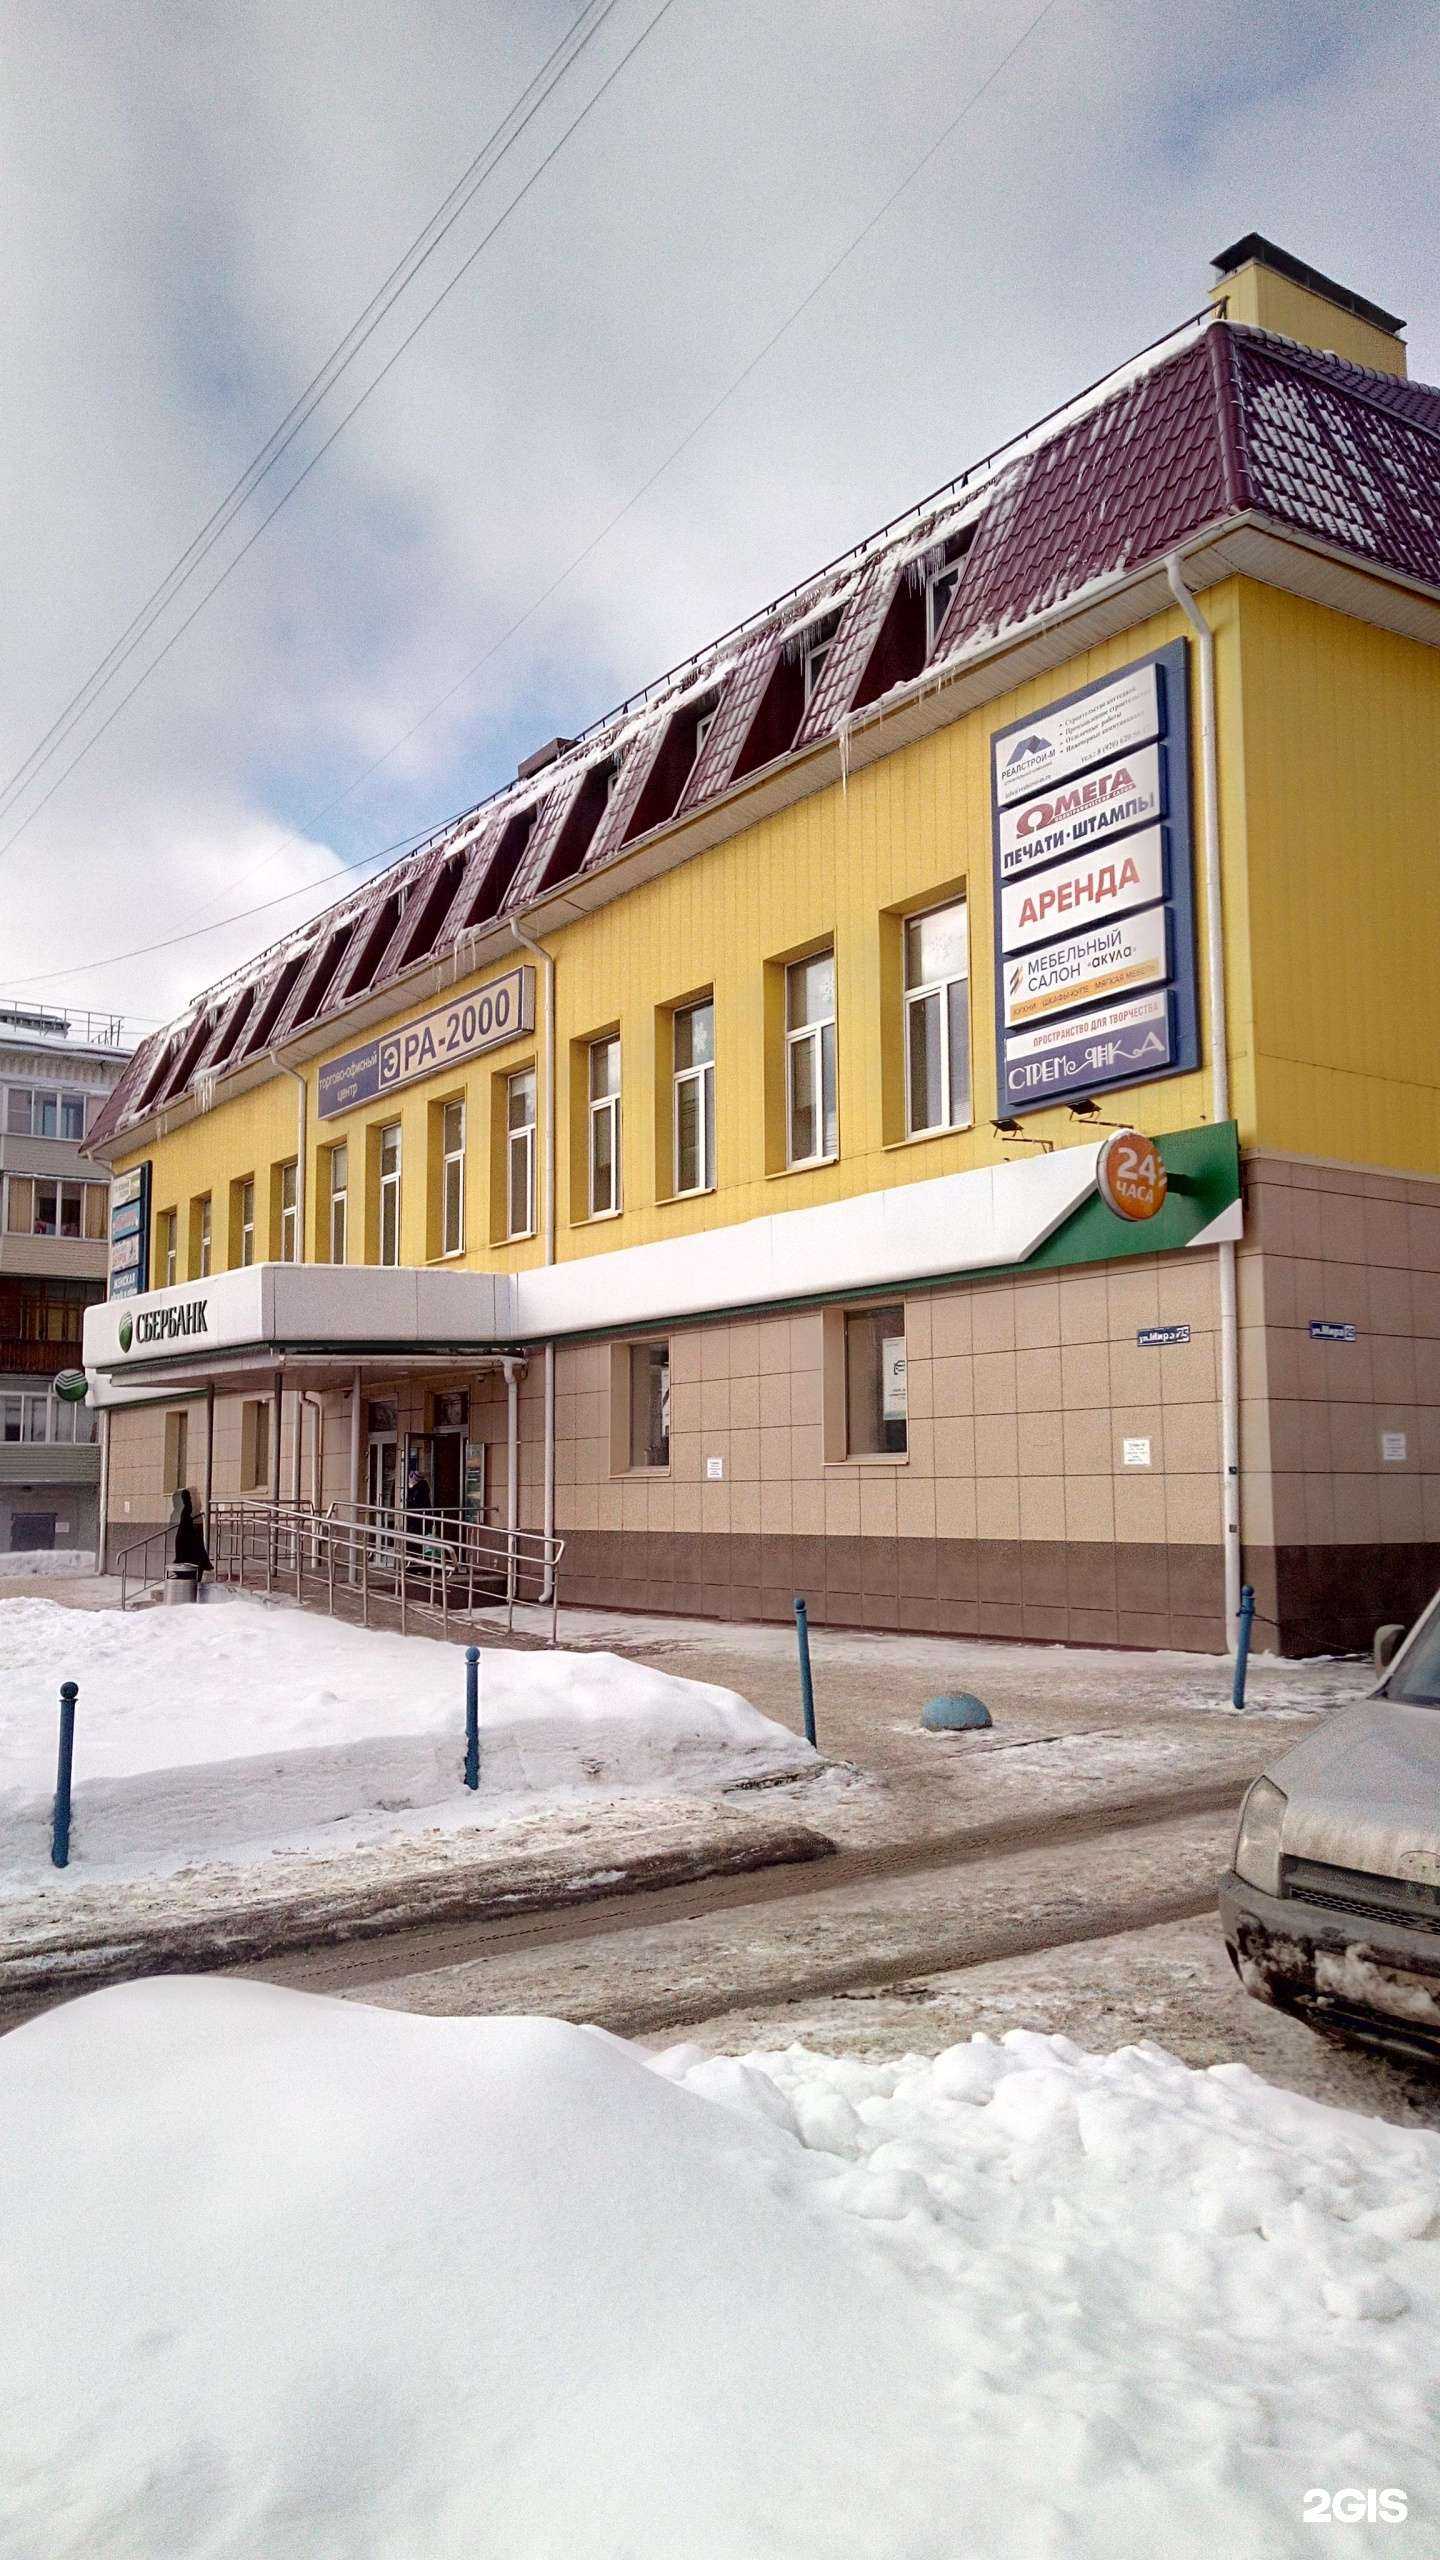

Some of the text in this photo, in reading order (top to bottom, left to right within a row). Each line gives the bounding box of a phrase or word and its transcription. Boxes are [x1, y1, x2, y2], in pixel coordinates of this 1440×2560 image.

[1018, 857, 1142, 928] АРЕНДА
[1027, 928, 1123, 975] МЕБЕЛЬНЫЙ
[1028, 962, 1081, 992] САЛОН
[382, 988, 511, 1079] ЭРА-2000
[1033, 1002, 1159, 1047] ПРОСТРАНСТВО ДЛЯ ТВОРЧЕСТВА
[336, 1083, 359, 1103] центр
[1118, 1147, 1157, 1186] 24
[1116, 1180, 1154, 1205] ЧАСА
[135, 1299, 208, 1344] СБЕРБАНК
